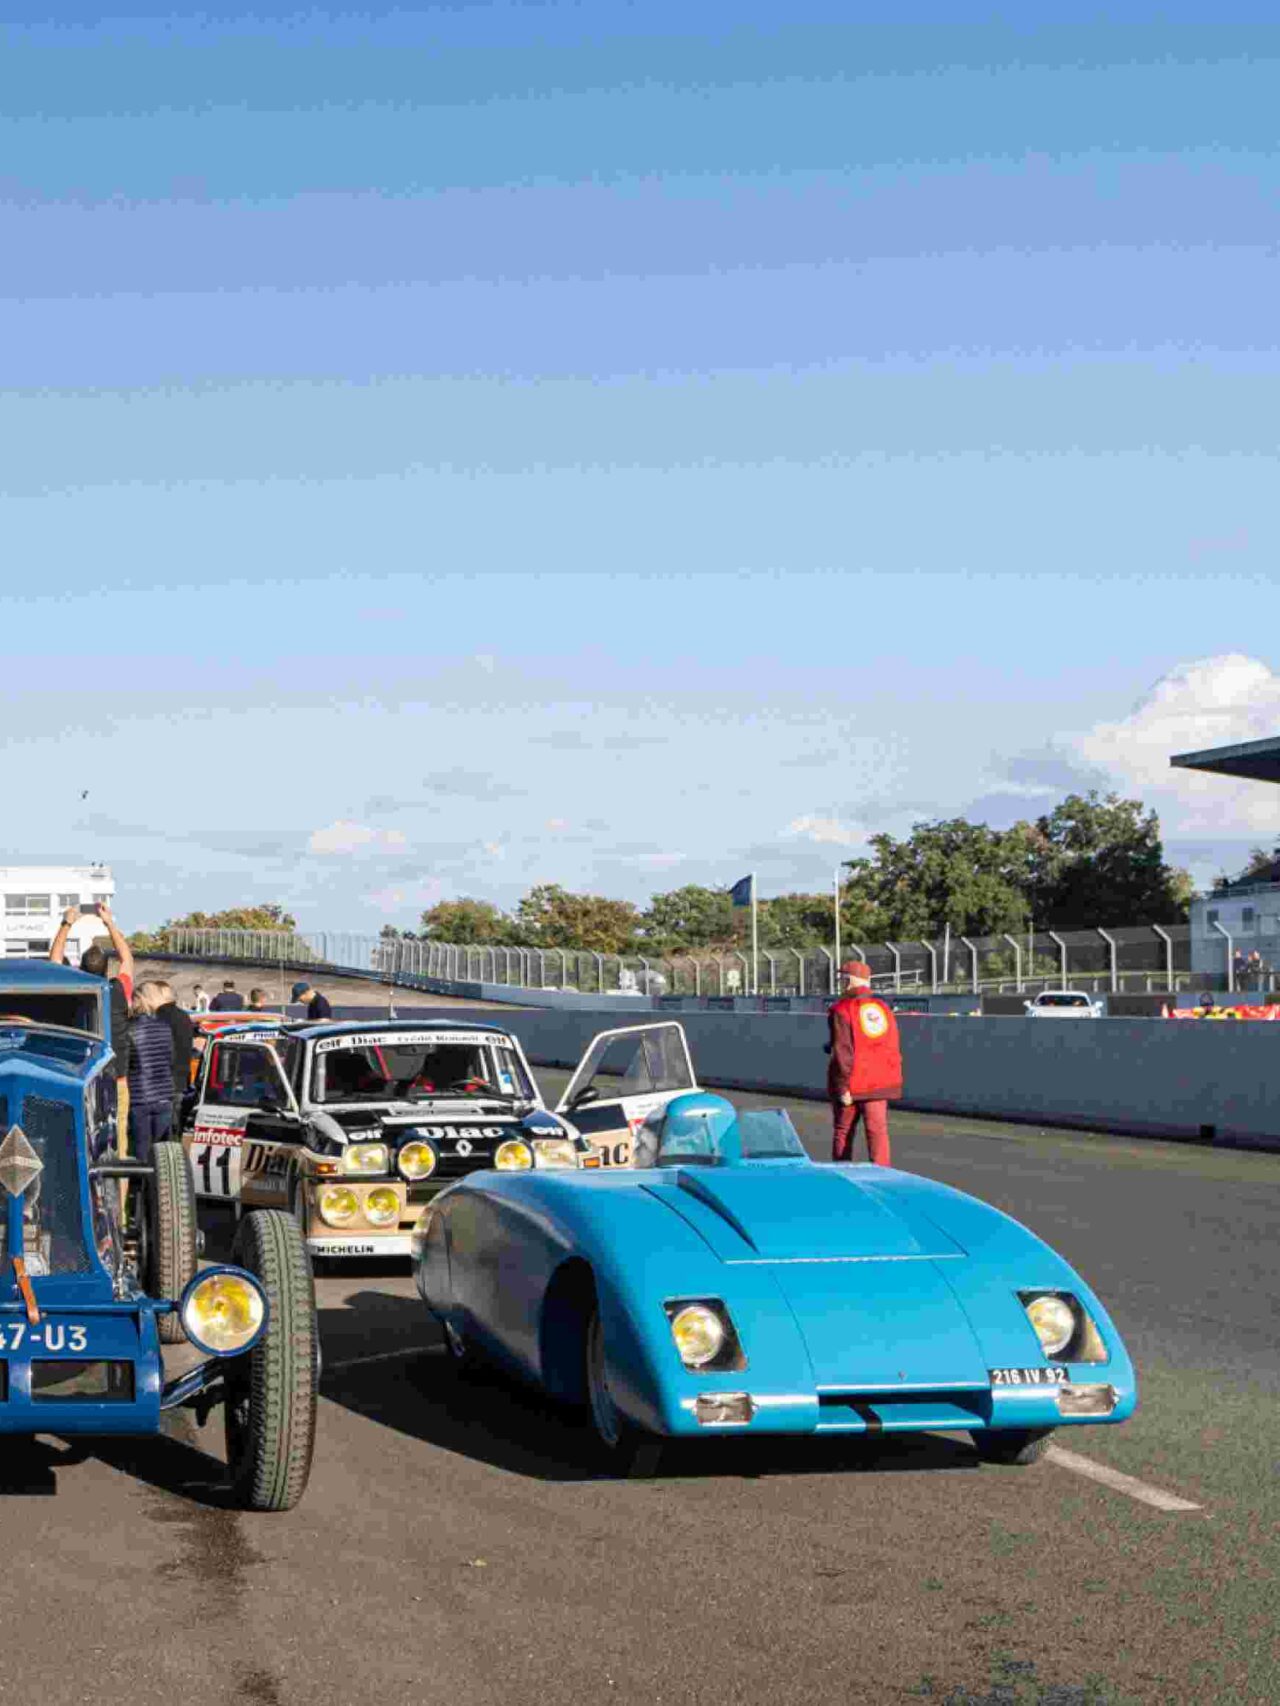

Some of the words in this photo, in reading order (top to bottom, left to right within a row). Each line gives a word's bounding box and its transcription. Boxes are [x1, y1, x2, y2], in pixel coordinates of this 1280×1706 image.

[193, 1126, 242, 1146] infotec
[197, 1145, 231, 1195] 11
[317, 1244, 375, 1254] MICHELIN
[1045, 1368, 1066, 1384] 92
